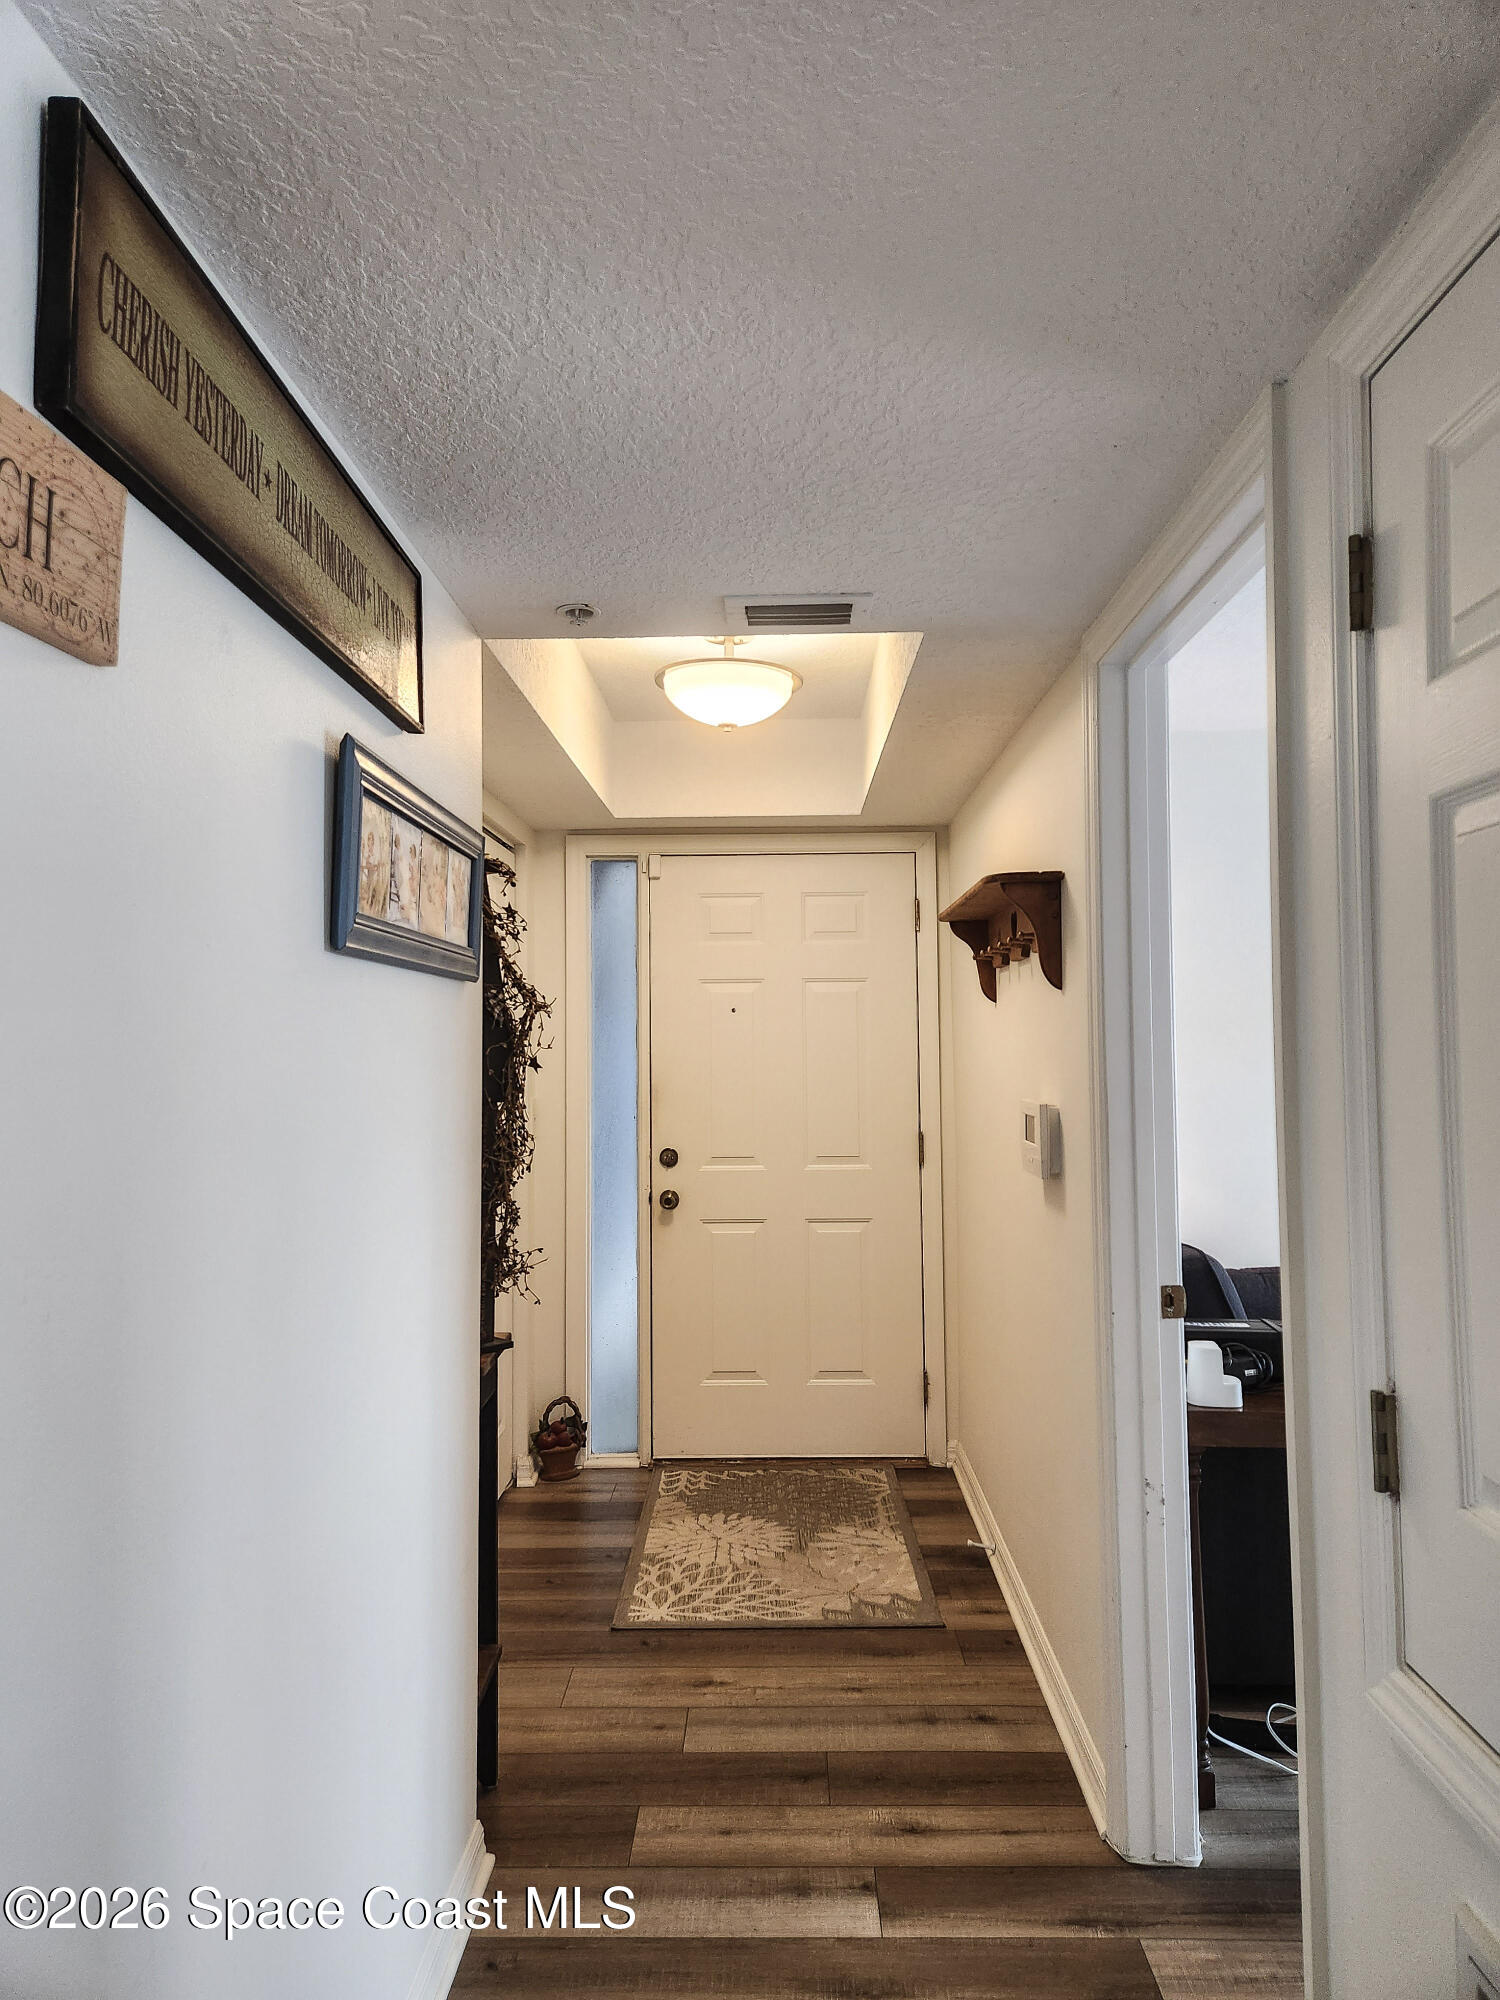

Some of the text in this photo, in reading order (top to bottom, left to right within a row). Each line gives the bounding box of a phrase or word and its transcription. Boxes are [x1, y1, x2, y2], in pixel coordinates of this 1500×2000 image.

[97, 251, 181, 411] CHERISH
[184, 347, 265, 502] YESTERDAY
[276, 460, 314, 559] DREAM
[314, 508, 368, 616] TOMORROW
[372, 576, 390, 641] LIVE
